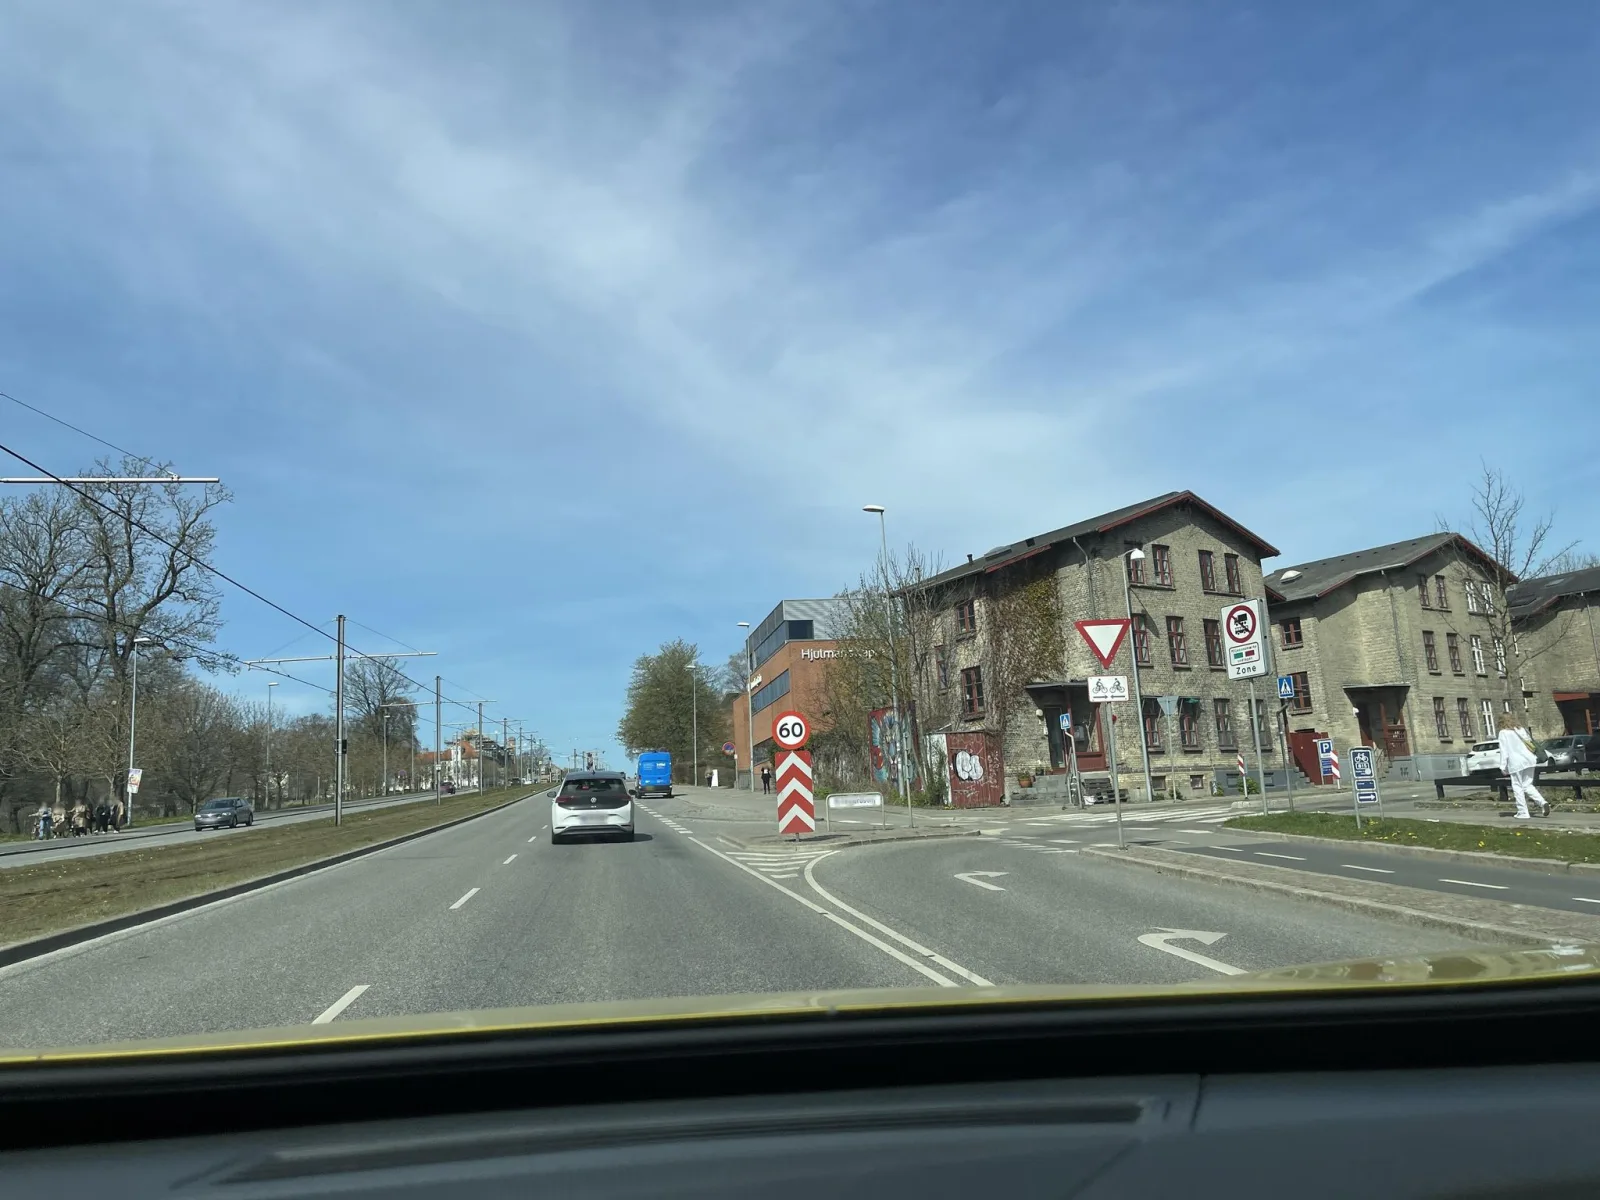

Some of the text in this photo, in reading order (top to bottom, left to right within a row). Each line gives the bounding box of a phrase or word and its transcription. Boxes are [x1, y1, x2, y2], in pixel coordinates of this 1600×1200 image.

[1236, 665, 1257, 675] Zone
[779, 722, 803, 738] 60
[1322, 742, 1330, 753] P
